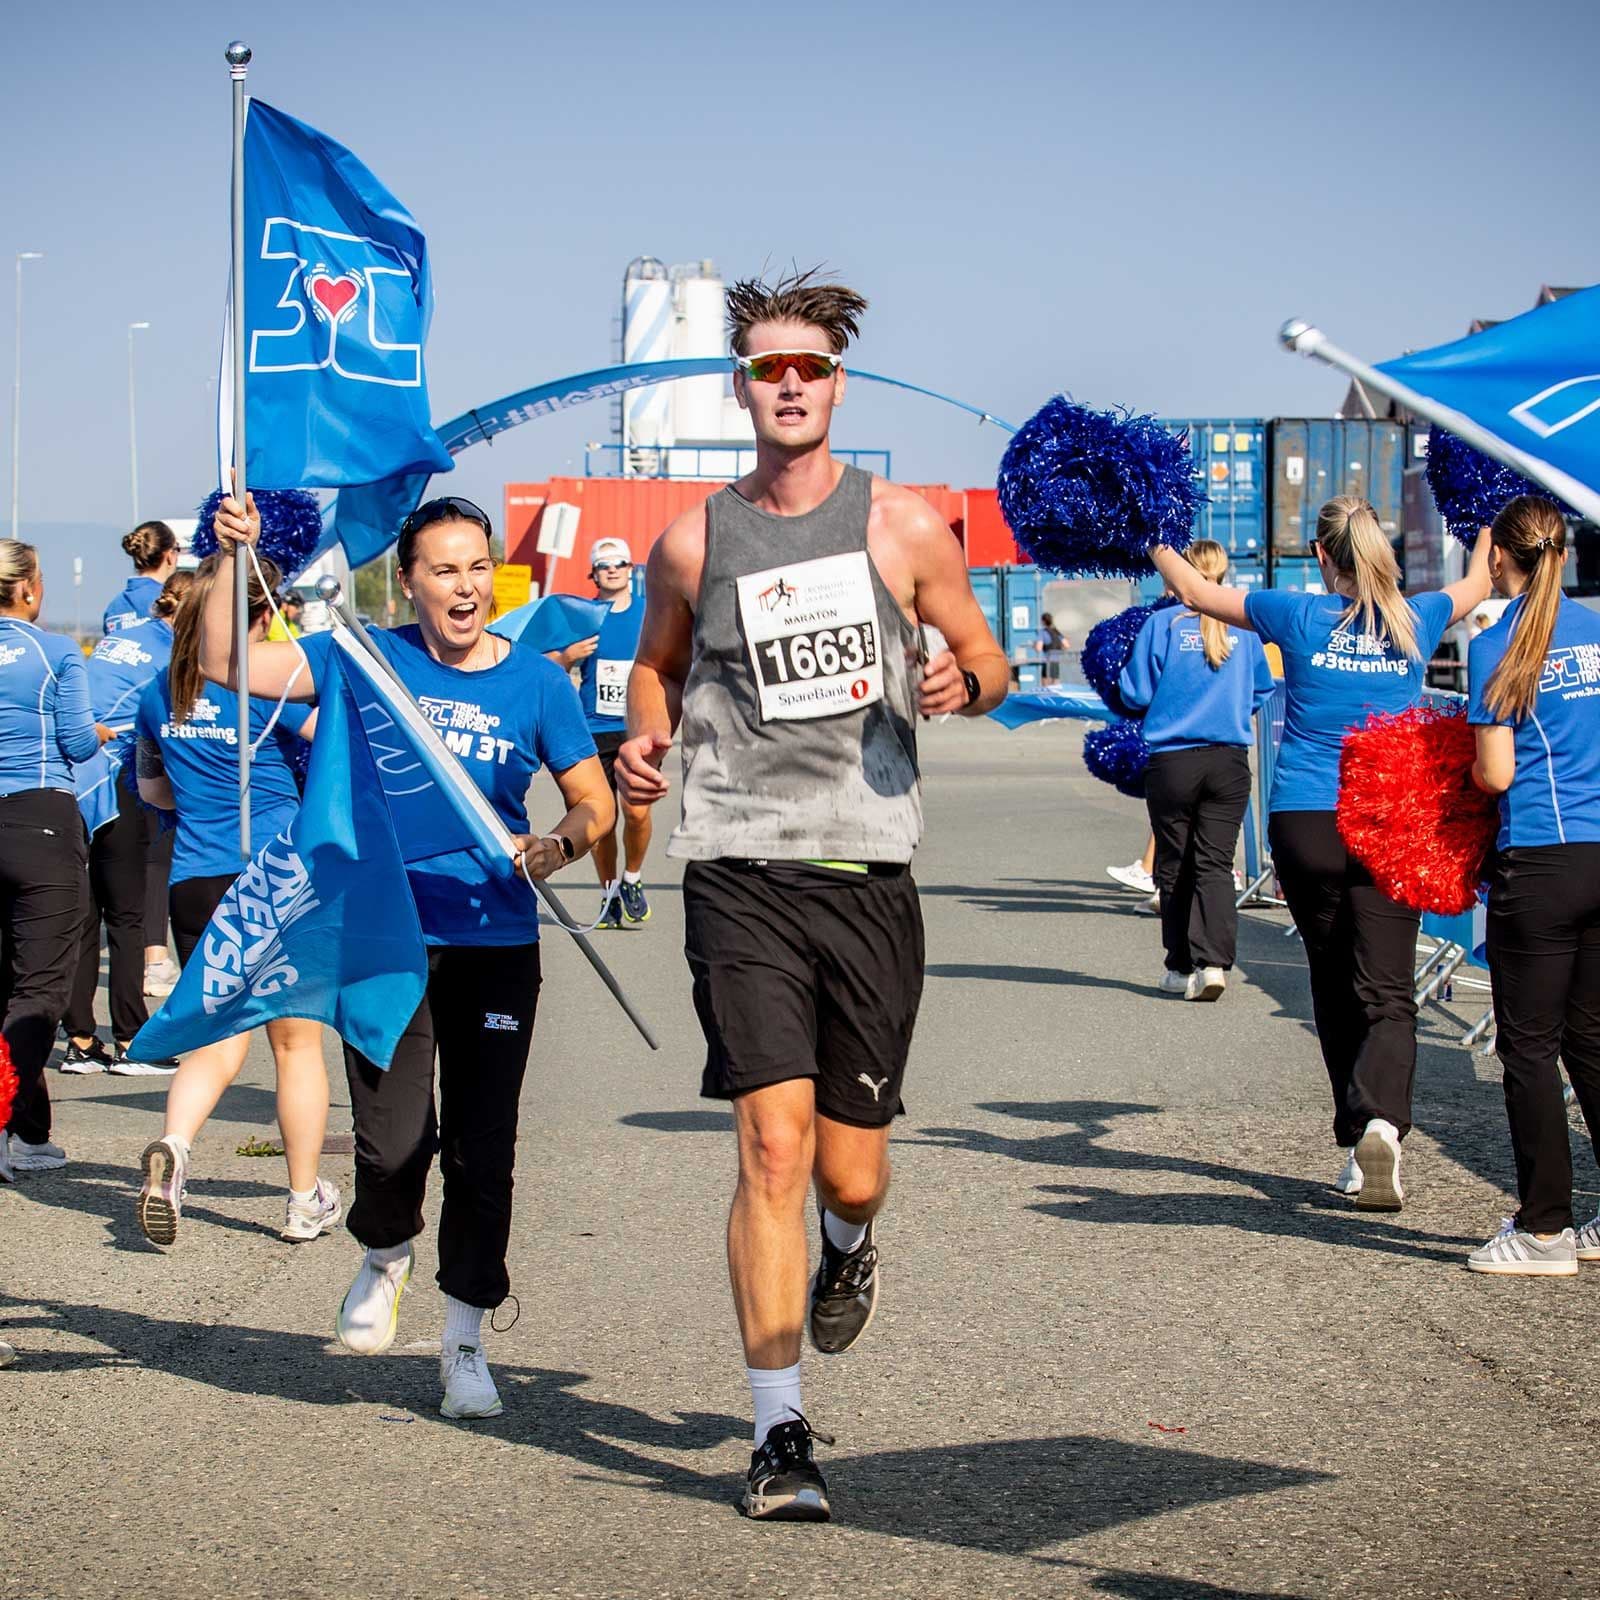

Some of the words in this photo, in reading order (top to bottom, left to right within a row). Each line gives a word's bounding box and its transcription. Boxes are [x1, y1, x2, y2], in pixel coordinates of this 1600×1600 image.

[784, 609, 838, 625] MARATON
[765, 626, 865, 682] 1663
[1311, 652, 1408, 676] #3ttrening
[778, 684, 848, 706] SpareBank
[476, 735, 515, 764] 3T
